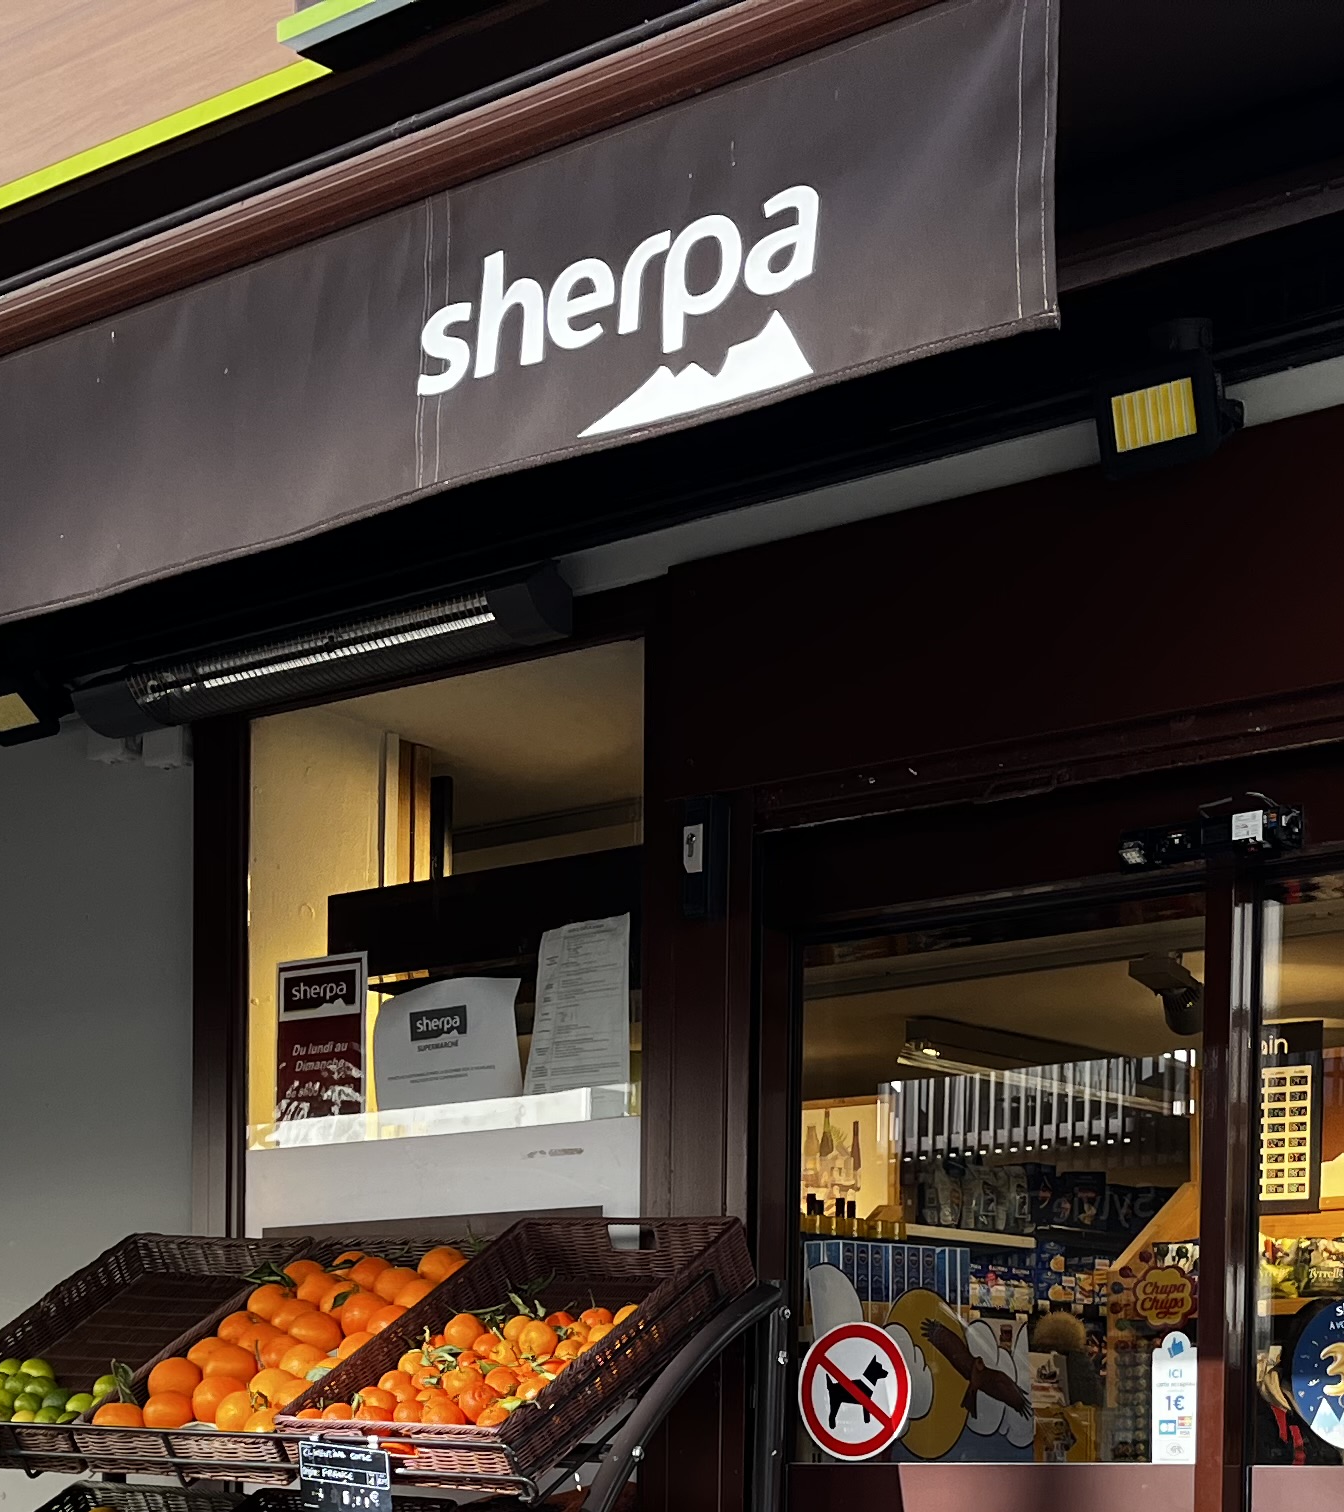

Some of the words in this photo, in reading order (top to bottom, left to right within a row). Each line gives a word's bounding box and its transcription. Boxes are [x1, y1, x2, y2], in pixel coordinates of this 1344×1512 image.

[417, 185, 820, 396] sherpa
[292, 982, 346, 1000] sherpa
[416, 1016, 460, 1032] sherpa
[292, 1044, 306, 1056] Du
[308, 1041, 333, 1054] lundi
[335, 1042, 348, 1053] au
[1143, 1282, 1186, 1298] Chupa
[1141, 1297, 1184, 1319] Chups
[1169, 1369, 1182, 1378] ICI
[1165, 1395, 1184, 1411] 1€
